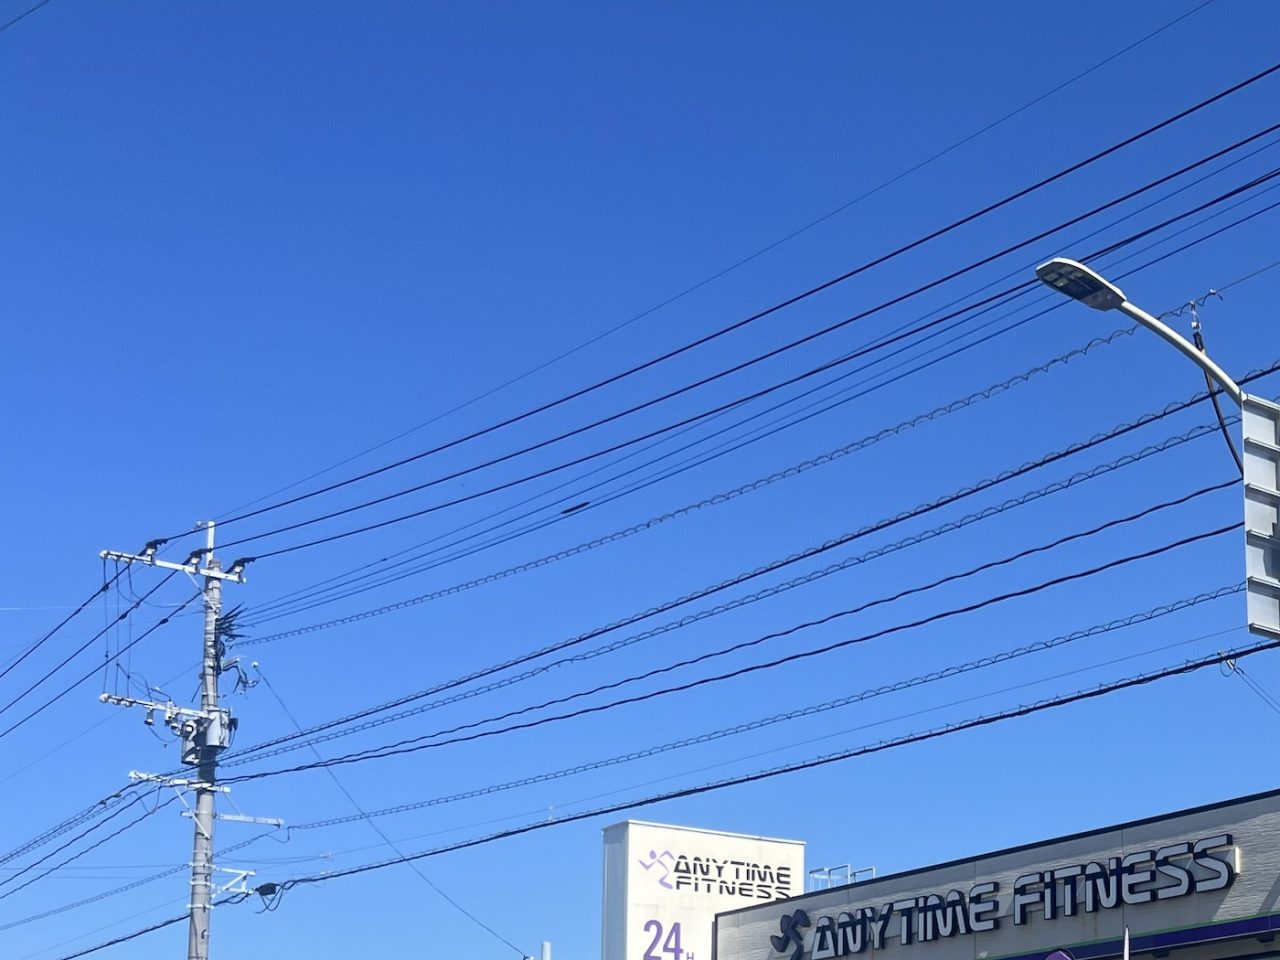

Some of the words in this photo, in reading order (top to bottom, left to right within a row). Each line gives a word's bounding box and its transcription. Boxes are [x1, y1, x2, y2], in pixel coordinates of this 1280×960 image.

[674, 854, 791, 885] ANYTIME
[676, 876, 791, 901] FITNESS
[811, 881, 999, 960] ANYTIME
[1013, 833, 1233, 925] FITNESS
